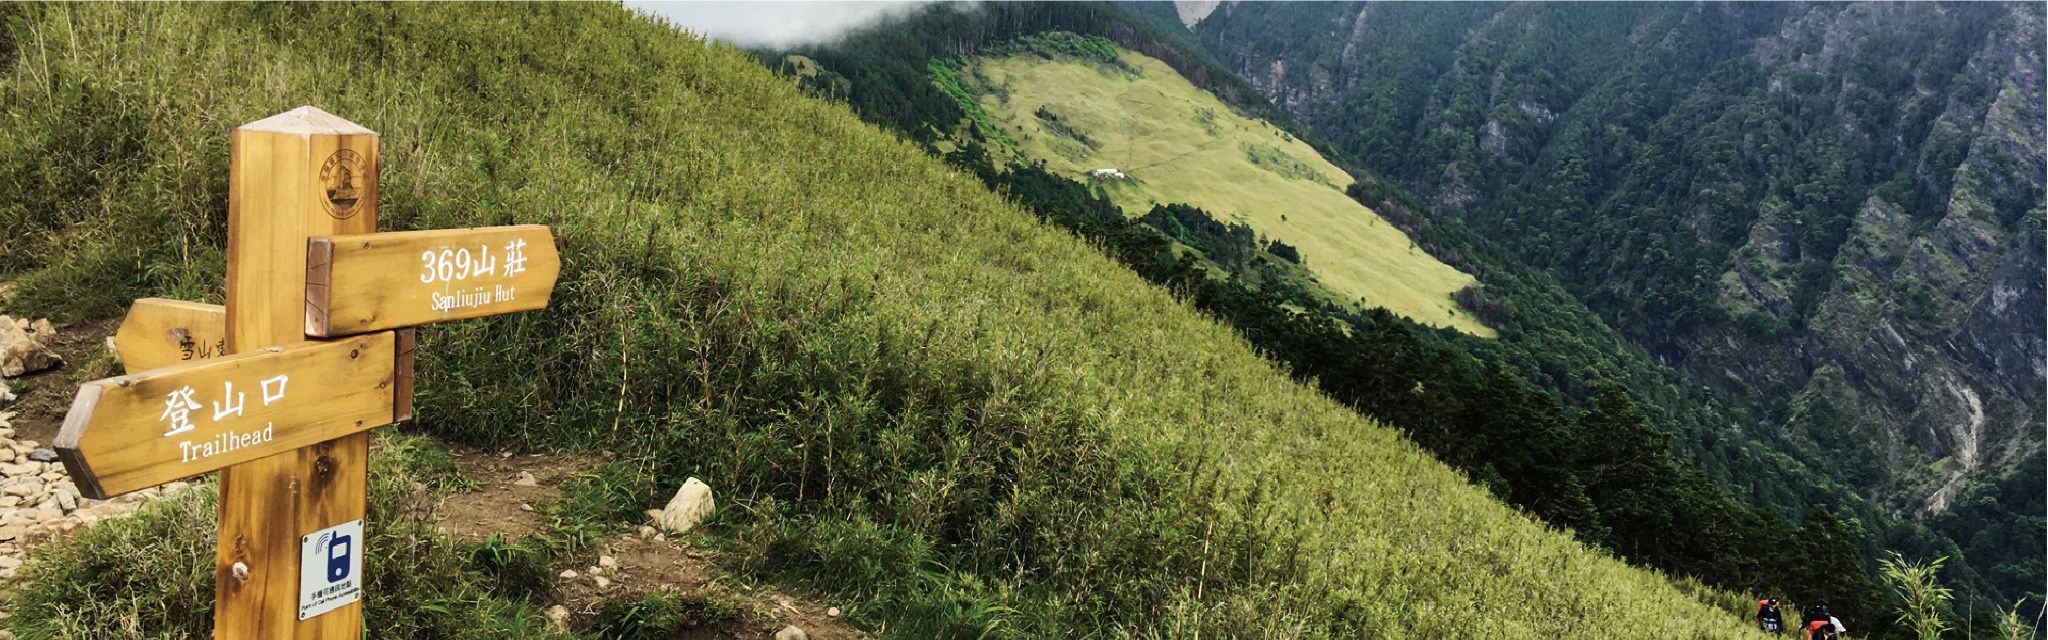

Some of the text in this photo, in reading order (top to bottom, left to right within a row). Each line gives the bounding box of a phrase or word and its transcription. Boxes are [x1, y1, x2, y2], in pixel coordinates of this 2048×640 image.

[431, 284, 516, 311] Sanliujiu Hut
[159, 374, 288, 437] 登山口
[179, 421, 273, 463] Trailhead
